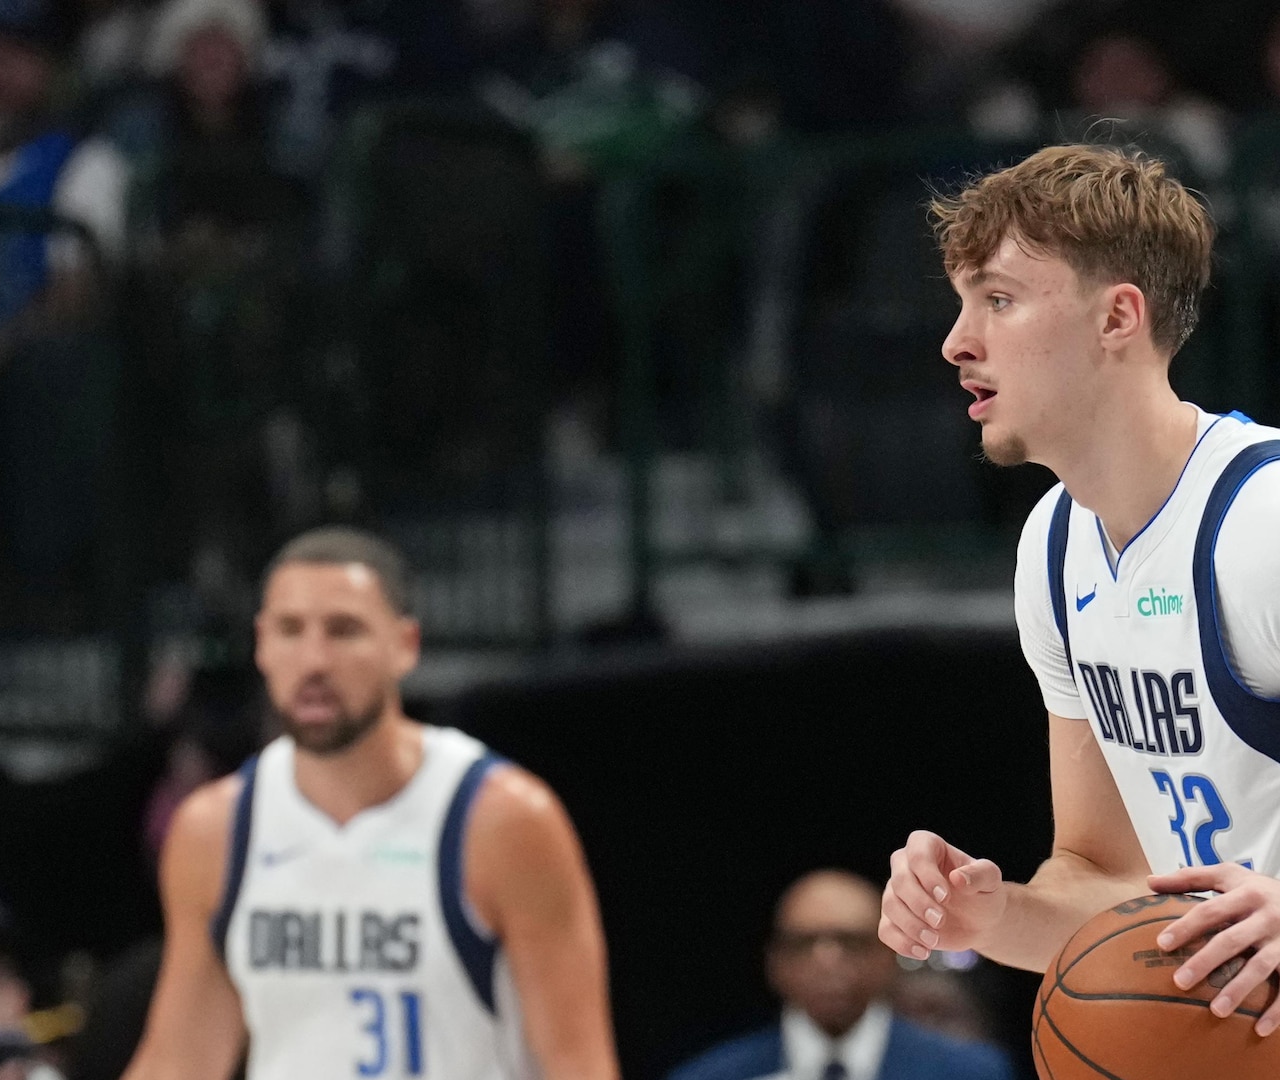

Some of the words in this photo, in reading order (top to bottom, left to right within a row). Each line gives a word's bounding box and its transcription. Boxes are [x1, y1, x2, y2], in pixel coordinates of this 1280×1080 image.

[1076, 660, 1205, 757] DALLAS
[1148, 767, 1255, 871] 32
[249, 908, 420, 973] DALLAS
[349, 987, 425, 1079] 31
